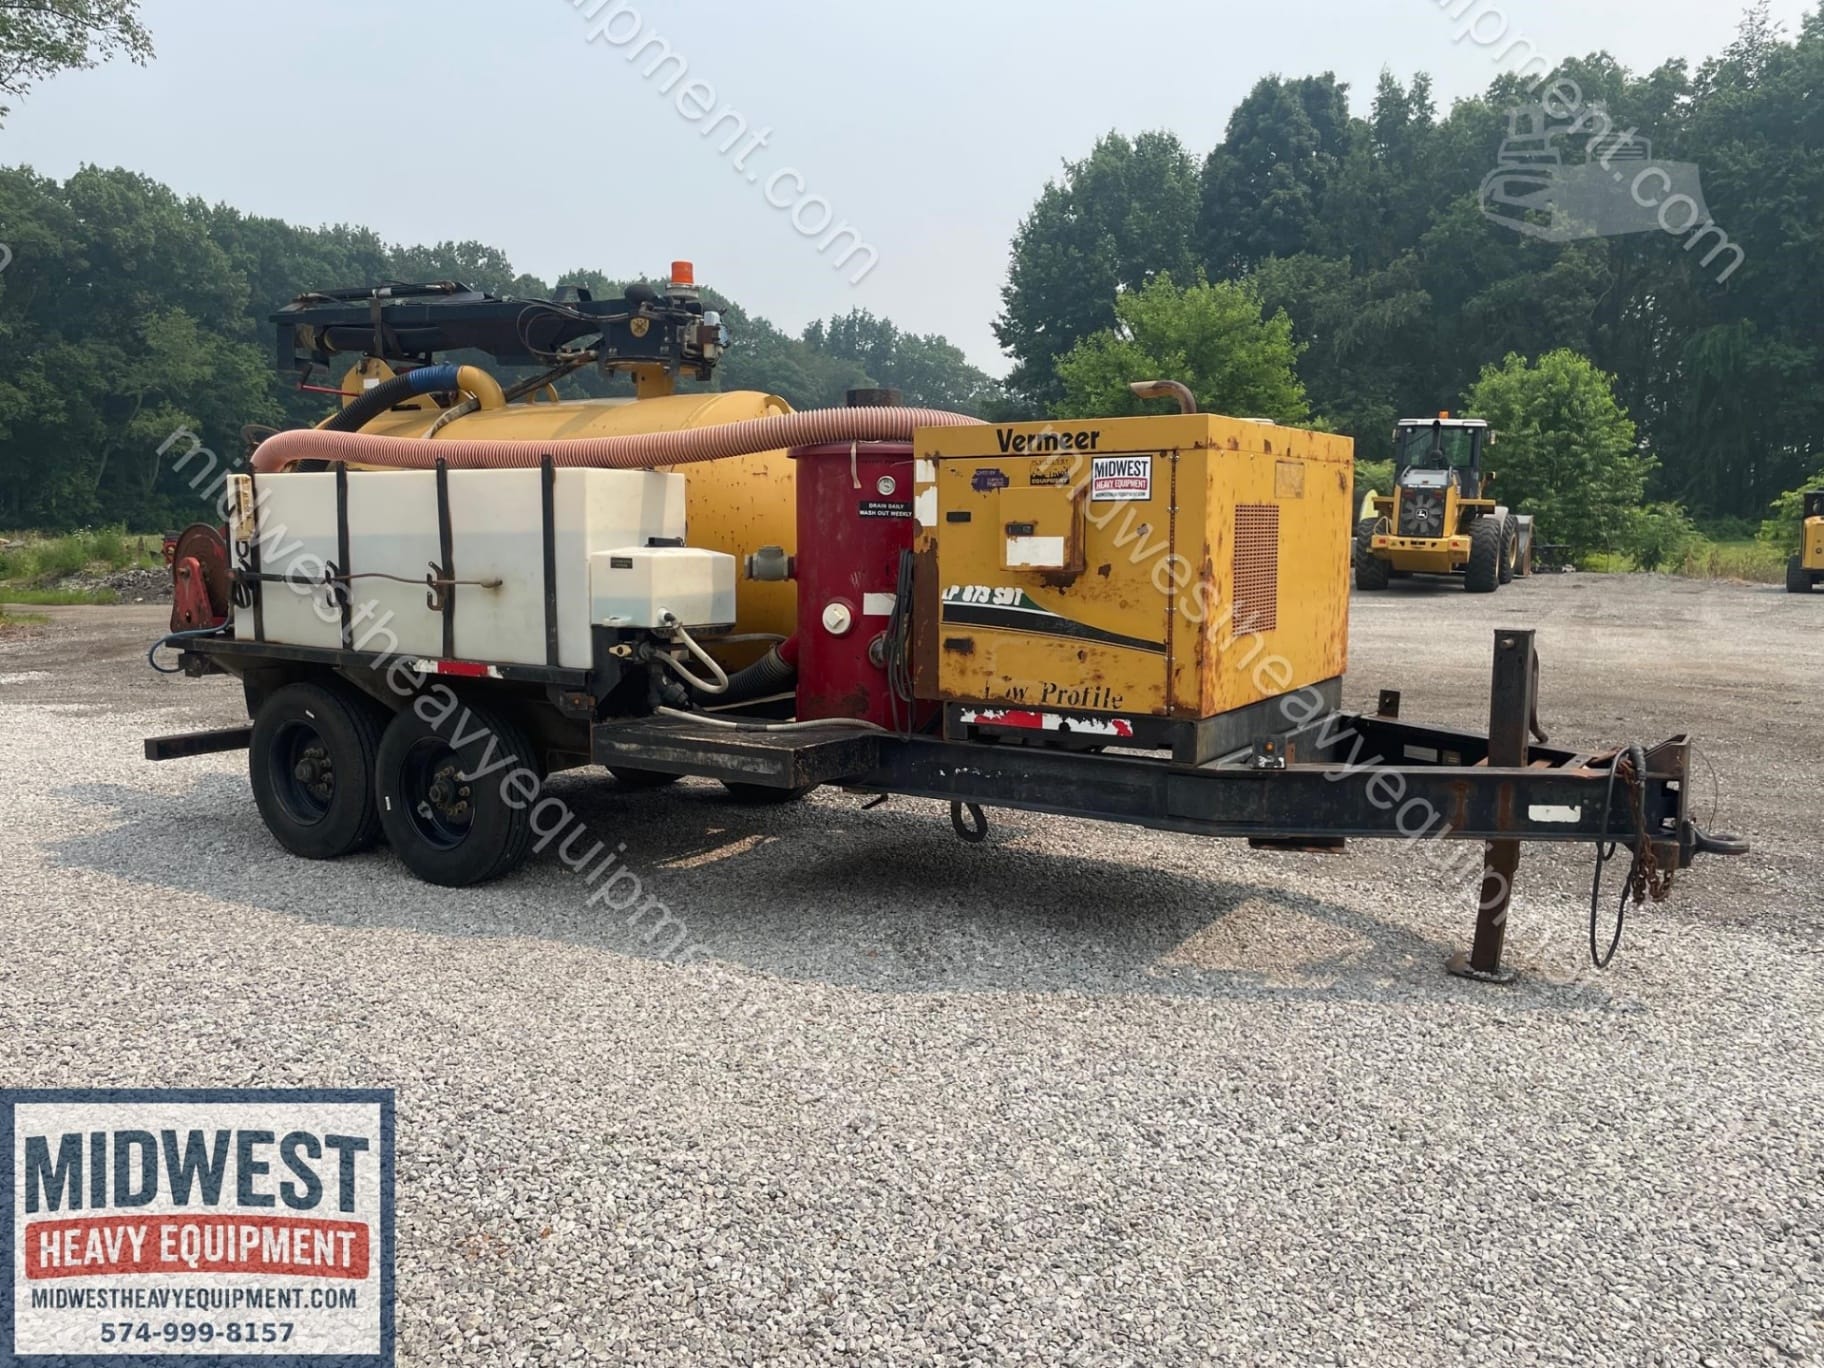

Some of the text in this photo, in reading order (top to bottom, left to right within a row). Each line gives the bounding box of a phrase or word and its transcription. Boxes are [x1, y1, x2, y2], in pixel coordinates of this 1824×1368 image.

[996, 428, 1100, 453] Vermeer
[1095, 460, 1148, 478] MIDWEST
[1041, 681, 1123, 709] Profile
